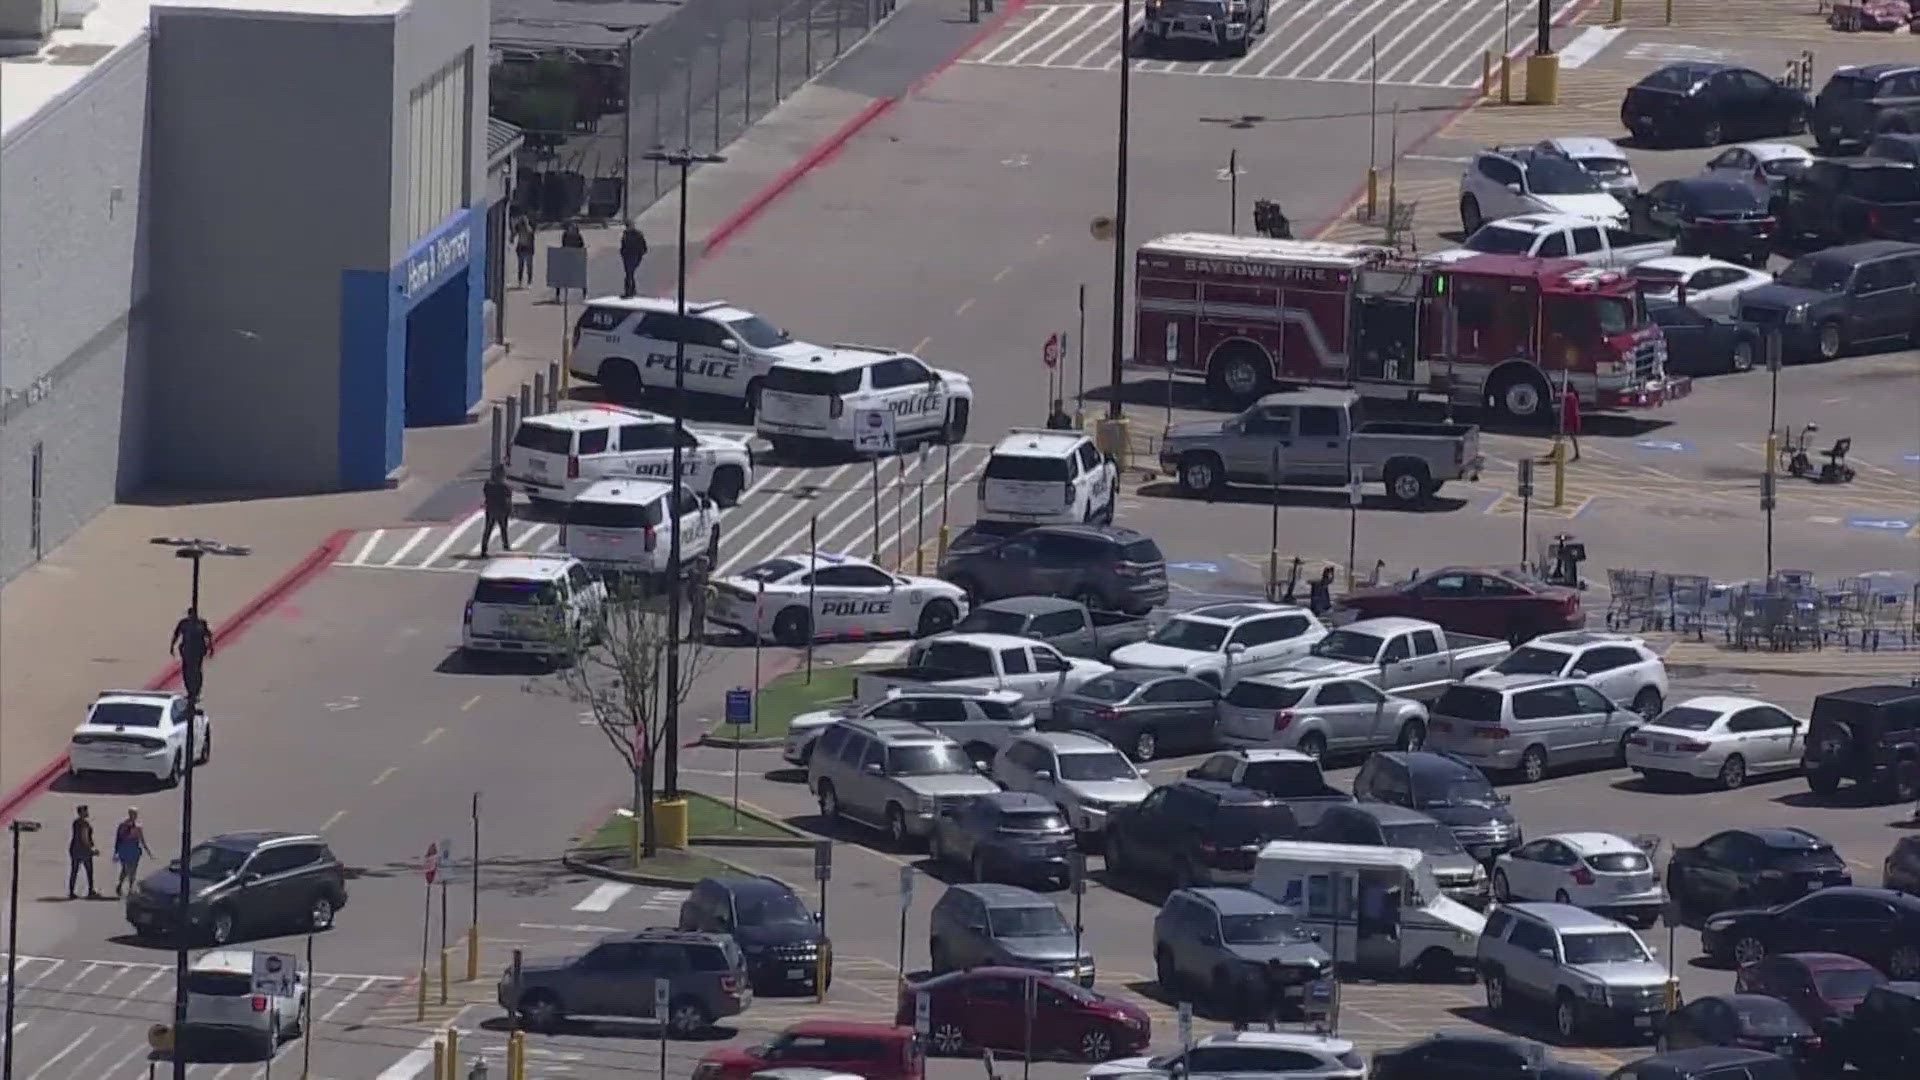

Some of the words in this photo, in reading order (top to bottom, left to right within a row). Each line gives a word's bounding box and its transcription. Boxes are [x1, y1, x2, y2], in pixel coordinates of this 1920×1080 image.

[1183, 259, 1277, 278] BAYTOWN
[1283, 266, 1326, 281] FIRE
[645, 353, 739, 379] POLICE
[888, 392, 941, 416] POLICE
[635, 460, 700, 476] POLCE
[821, 601, 892, 616] POLICE
